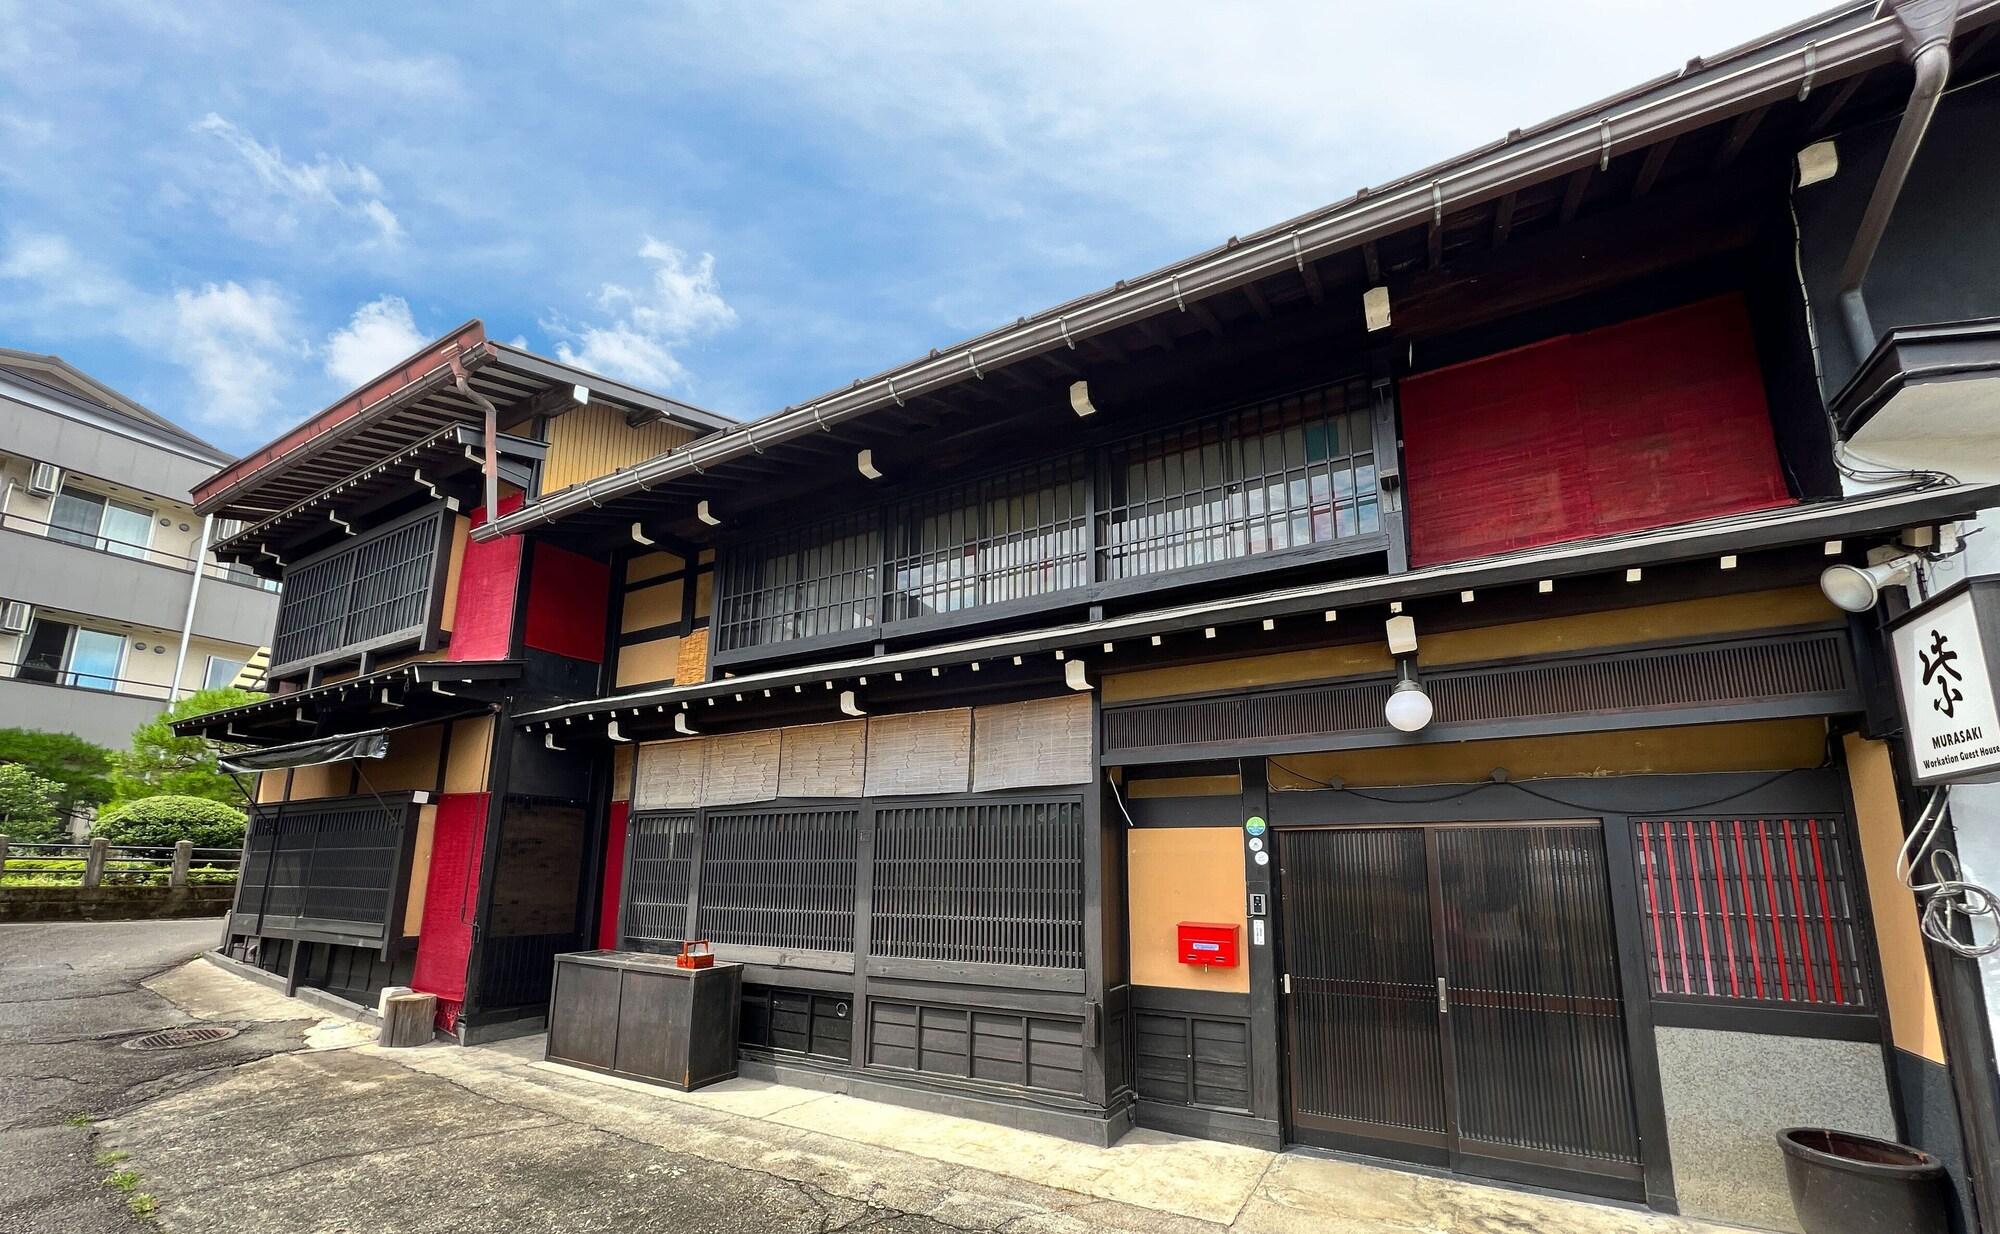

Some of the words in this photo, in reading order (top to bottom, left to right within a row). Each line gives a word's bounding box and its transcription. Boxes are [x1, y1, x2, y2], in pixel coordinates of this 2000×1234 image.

[1931, 726, 1983, 749] MURASAKI
[1923, 754, 1959, 769] Workation
[1960, 749, 1979, 761] Guest
[1979, 745, 2000, 757] House
